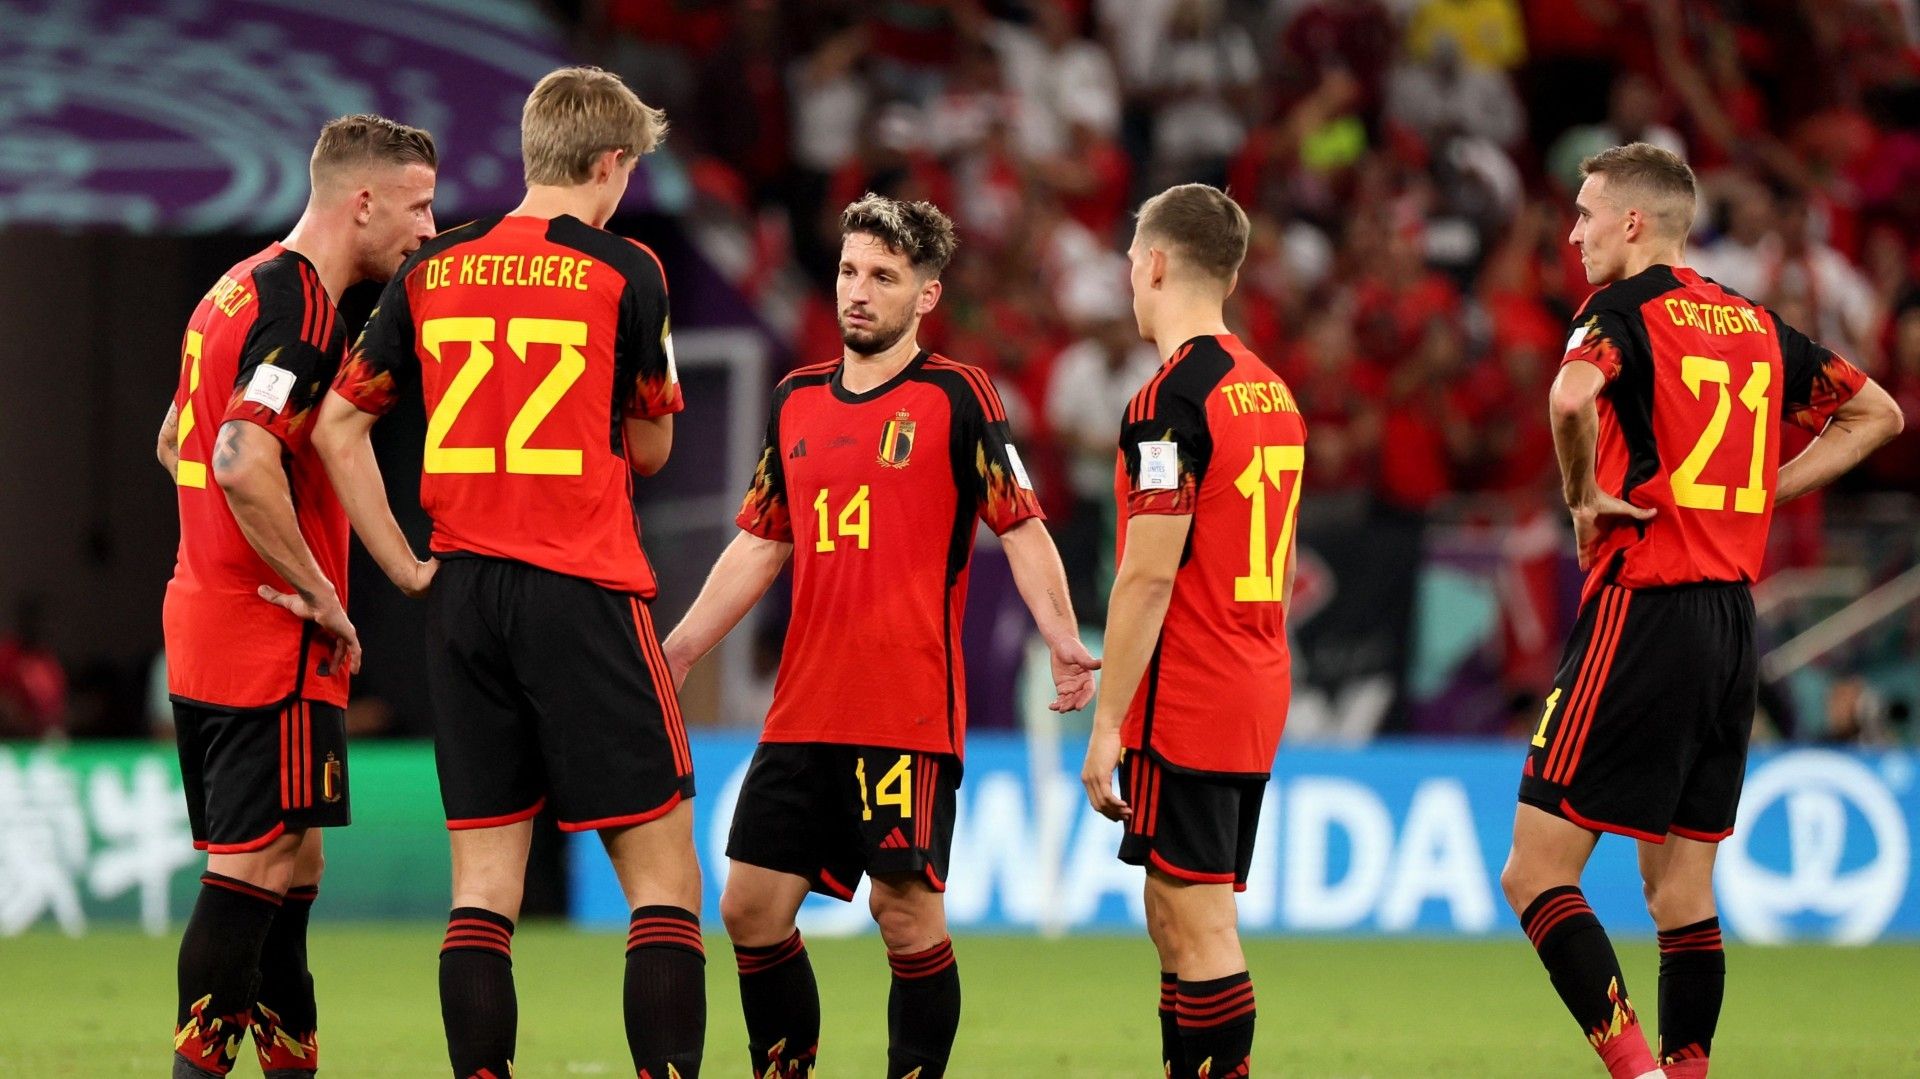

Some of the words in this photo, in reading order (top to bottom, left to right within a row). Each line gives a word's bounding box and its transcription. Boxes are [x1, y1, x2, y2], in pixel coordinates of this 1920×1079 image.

[426, 255, 454, 290] DE
[459, 254, 593, 291] KETELAERE
[177, 328, 207, 489] 2
[422, 316, 588, 476] 22
[1670, 355, 1771, 514] 21
[813, 484, 870, 553] 14
[1234, 445, 1305, 602] 17
[855, 754, 912, 821] 14
